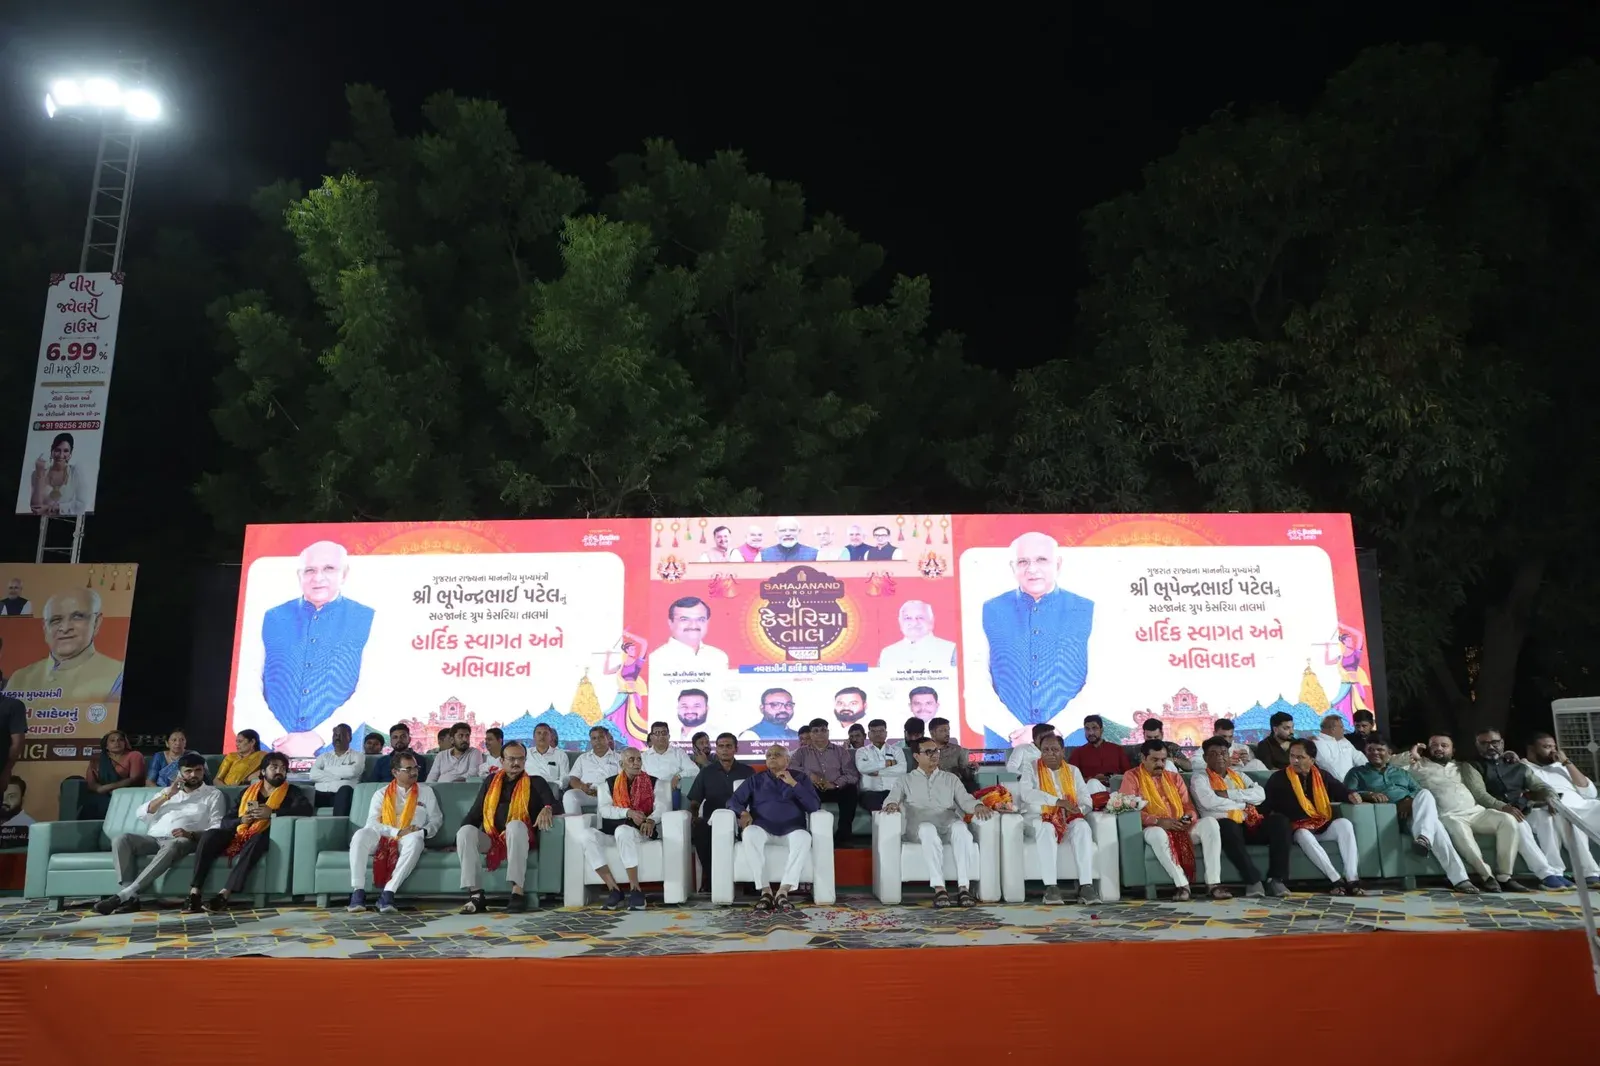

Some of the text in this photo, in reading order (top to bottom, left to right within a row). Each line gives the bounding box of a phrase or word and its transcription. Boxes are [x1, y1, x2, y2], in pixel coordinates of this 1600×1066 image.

[69, 275, 104, 297] વીરા
[57, 298, 110, 320] જ્વેલરી
[63, 319, 97, 334] હાઉસ
[43, 363, 54, 375] થી
[1147, 567, 1171, 577] ગુજરાત
[1173, 567, 1200, 575] રાજ્યના
[1202, 565, 1230, 574] માનનીય
[432, 575, 457, 585] ગુજરાત
[459, 575, 486, 583] રાજ્યના
[488, 573, 517, 582] માનનીય
[764, 582, 840, 590] SAHAJANAND
[1130, 577, 1148, 596] શ્રી
[1154, 576, 1233, 601] ભૂપેન્દ્રભાઈ
[412, 585, 431, 604] શ્રી
[437, 584, 519, 609] ભૂપેન્દ્રભાઈ
[1149, 601, 1266, 615] સહજાનંદ ગ્રુપ કેસરિયા તાલમાં
[429, 609, 549, 623] સહજાનંદ ગ્રુપ કેસરિયા તાલમાં
[759, 607, 843, 628] કેસરિયા
[780, 628, 824, 643] તાલ
[1135, 617, 1283, 642] હાર્દિક સ્વાગત અને
[411, 626, 564, 650] હાર્દિક સ્વાગત અને
[1168, 647, 1256, 669] અભિવાદન
[441, 656, 531, 677] અભિવાદન
[36, 707, 79, 721] સાહેબનું
[63, 722, 75, 733] છે
